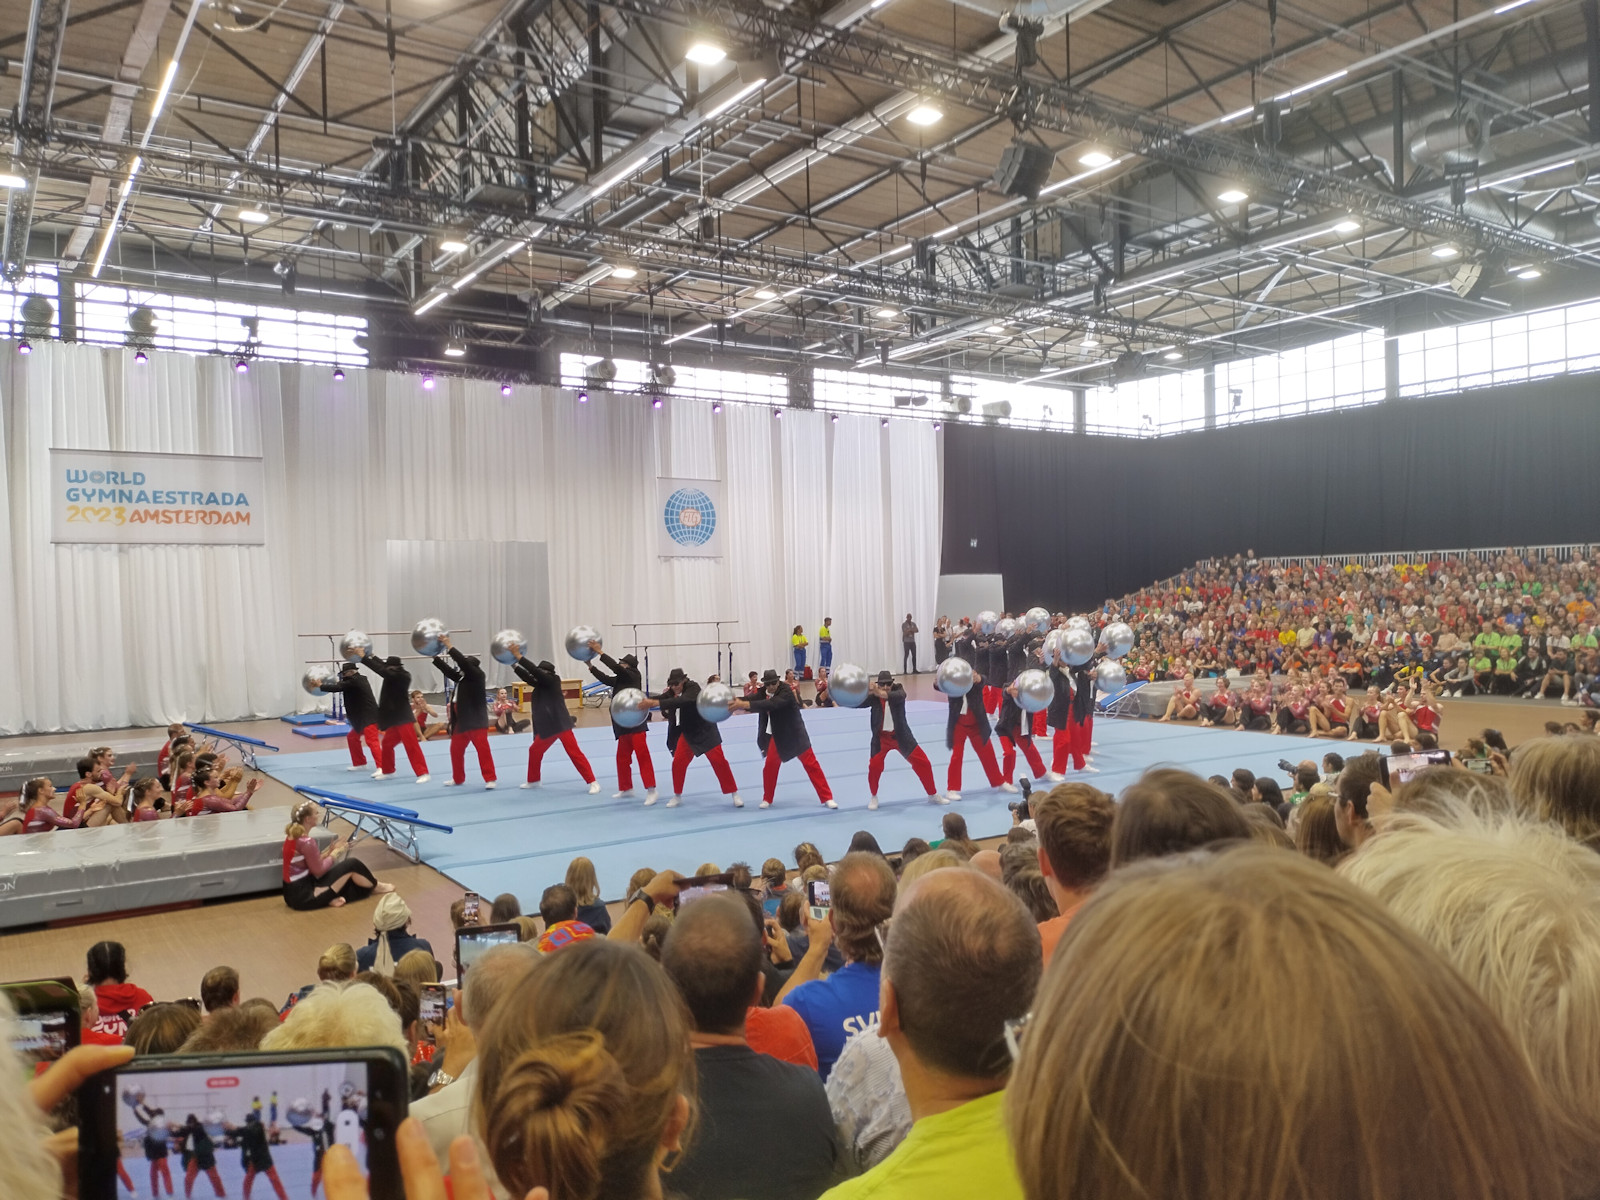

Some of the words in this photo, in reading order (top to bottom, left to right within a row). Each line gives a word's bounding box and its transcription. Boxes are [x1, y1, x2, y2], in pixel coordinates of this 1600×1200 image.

[66, 469, 145, 486] WORLD
[66, 487, 249, 506] GYMNAESTRADA
[66, 505, 126, 526] 2023
[129, 509, 250, 526] AMSTERDAM
